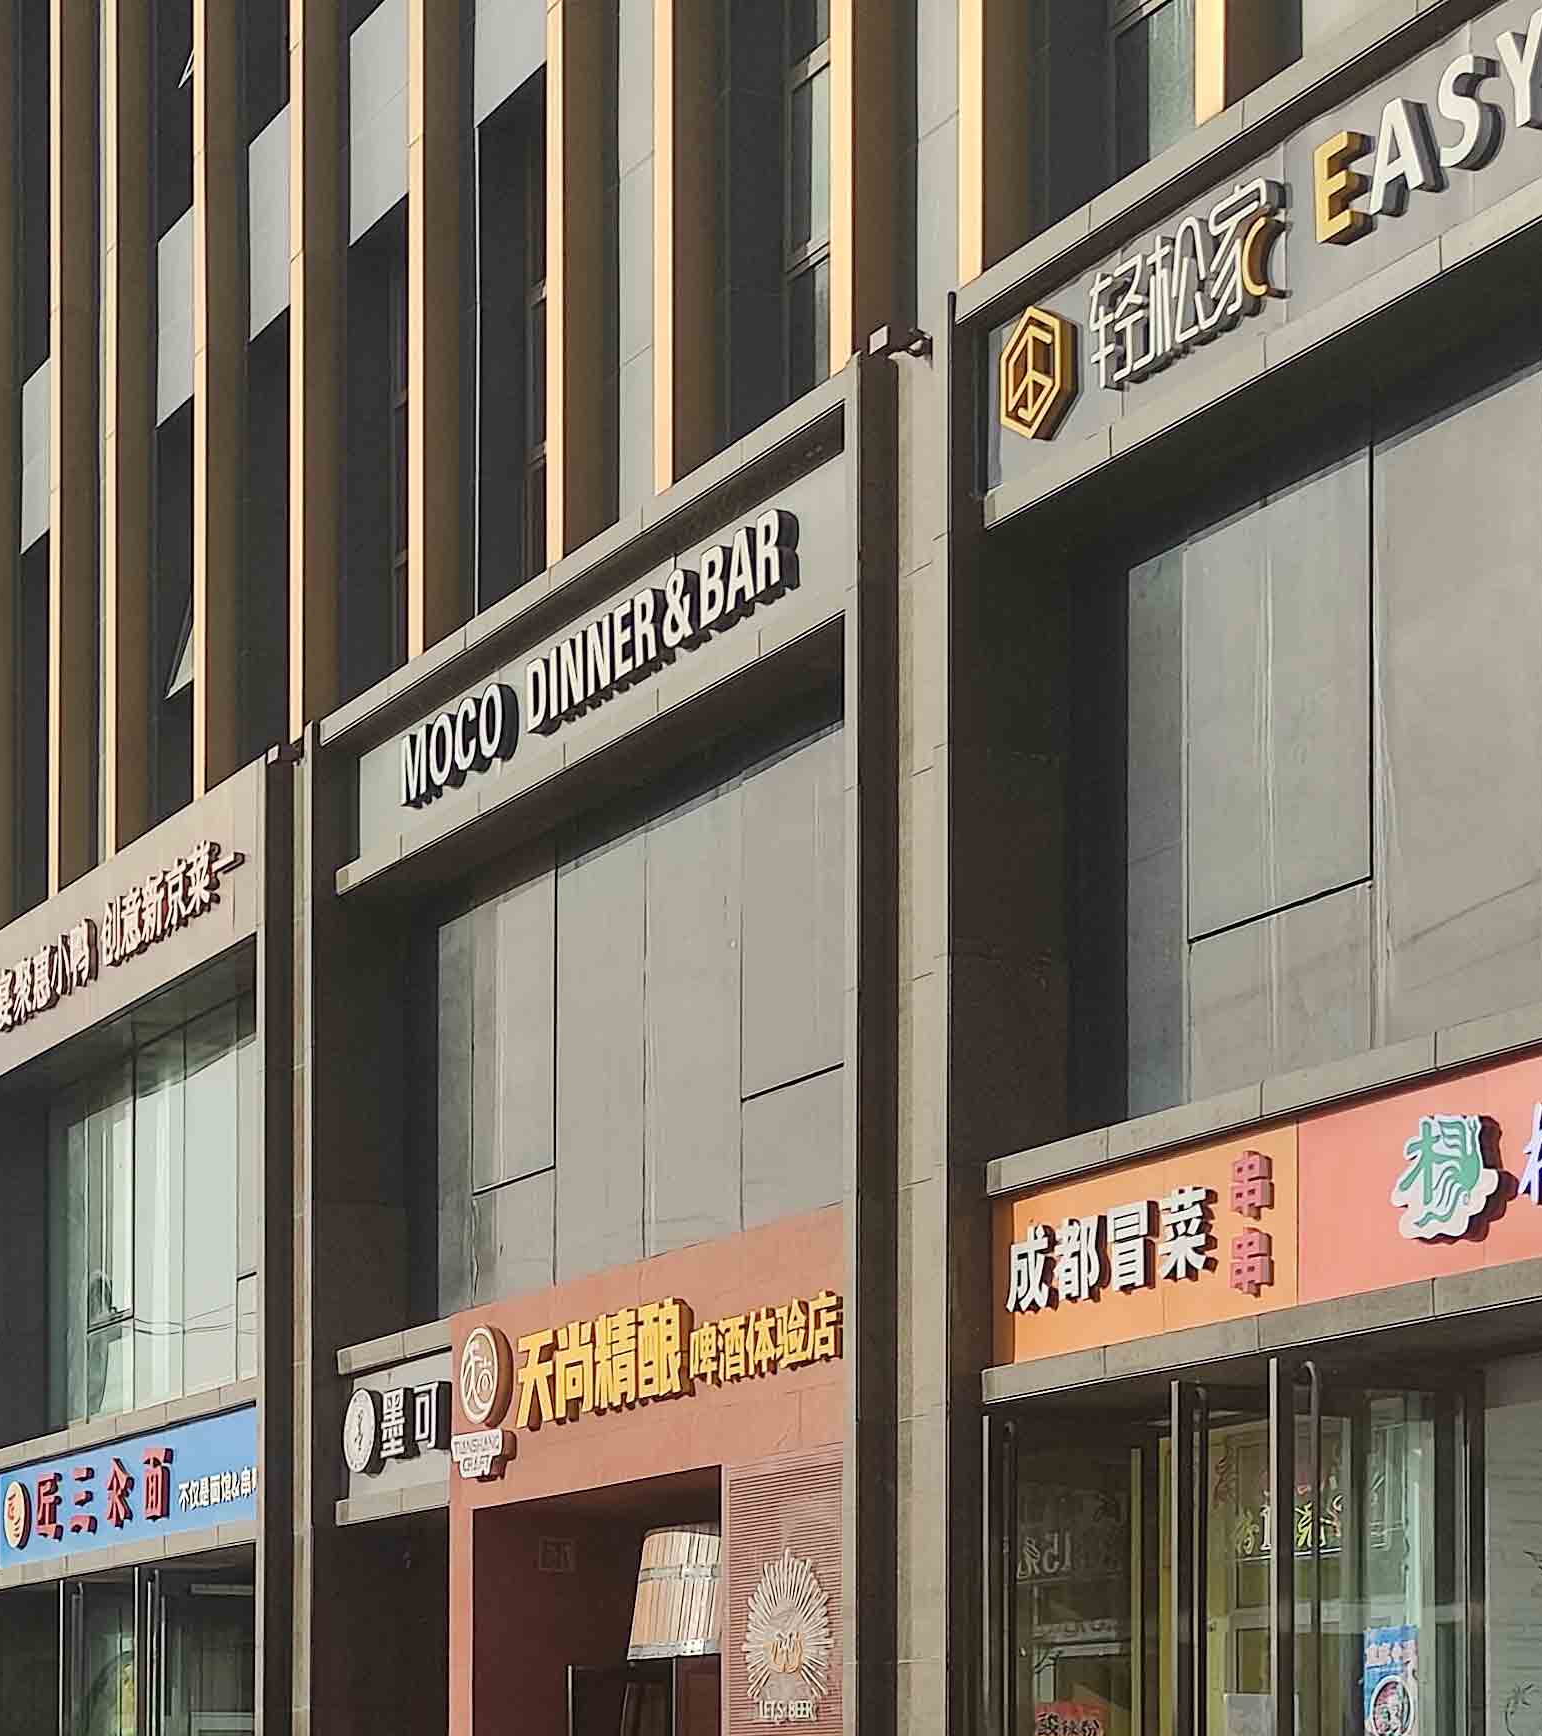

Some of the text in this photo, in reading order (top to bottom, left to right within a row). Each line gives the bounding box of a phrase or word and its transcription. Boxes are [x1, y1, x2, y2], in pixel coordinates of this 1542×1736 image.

[1090, 177, 1268, 390] 轻松家
[401, 508, 784, 805] MOCO DINNER & BAR
[1006, 1185, 1208, 1313] 成都冒菜
[1229, 1150, 1272, 1297] 串串
[516, 1290, 837, 1428] 天尚精酿 啤酒体验店
